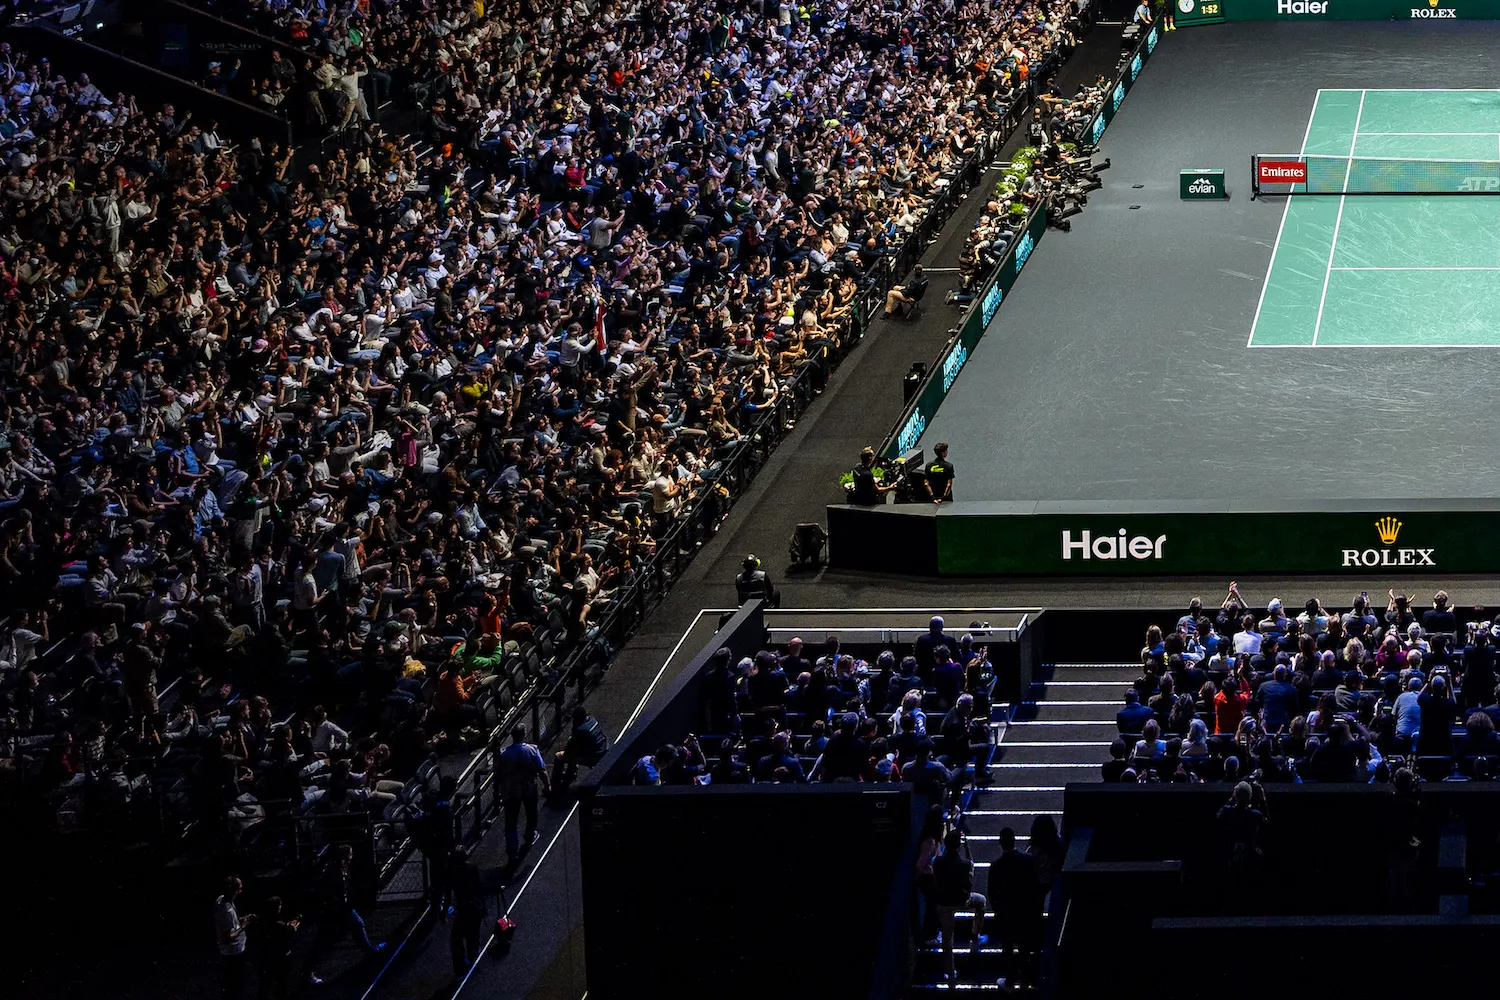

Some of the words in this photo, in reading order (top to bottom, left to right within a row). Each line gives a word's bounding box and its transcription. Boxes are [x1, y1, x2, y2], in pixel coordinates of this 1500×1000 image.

[1201, 4, 1219, 15] 1:52
[1411, 8, 1457, 19] ROLEX
[1261, 166, 1304, 178] Emirates
[1188, 183, 1216, 195] evian
[1457, 177, 1500, 191] ATP
[1061, 527, 1167, 560] Haier
[1341, 549, 1436, 567] ROLEX
[875, 801, 888, 809] C2
